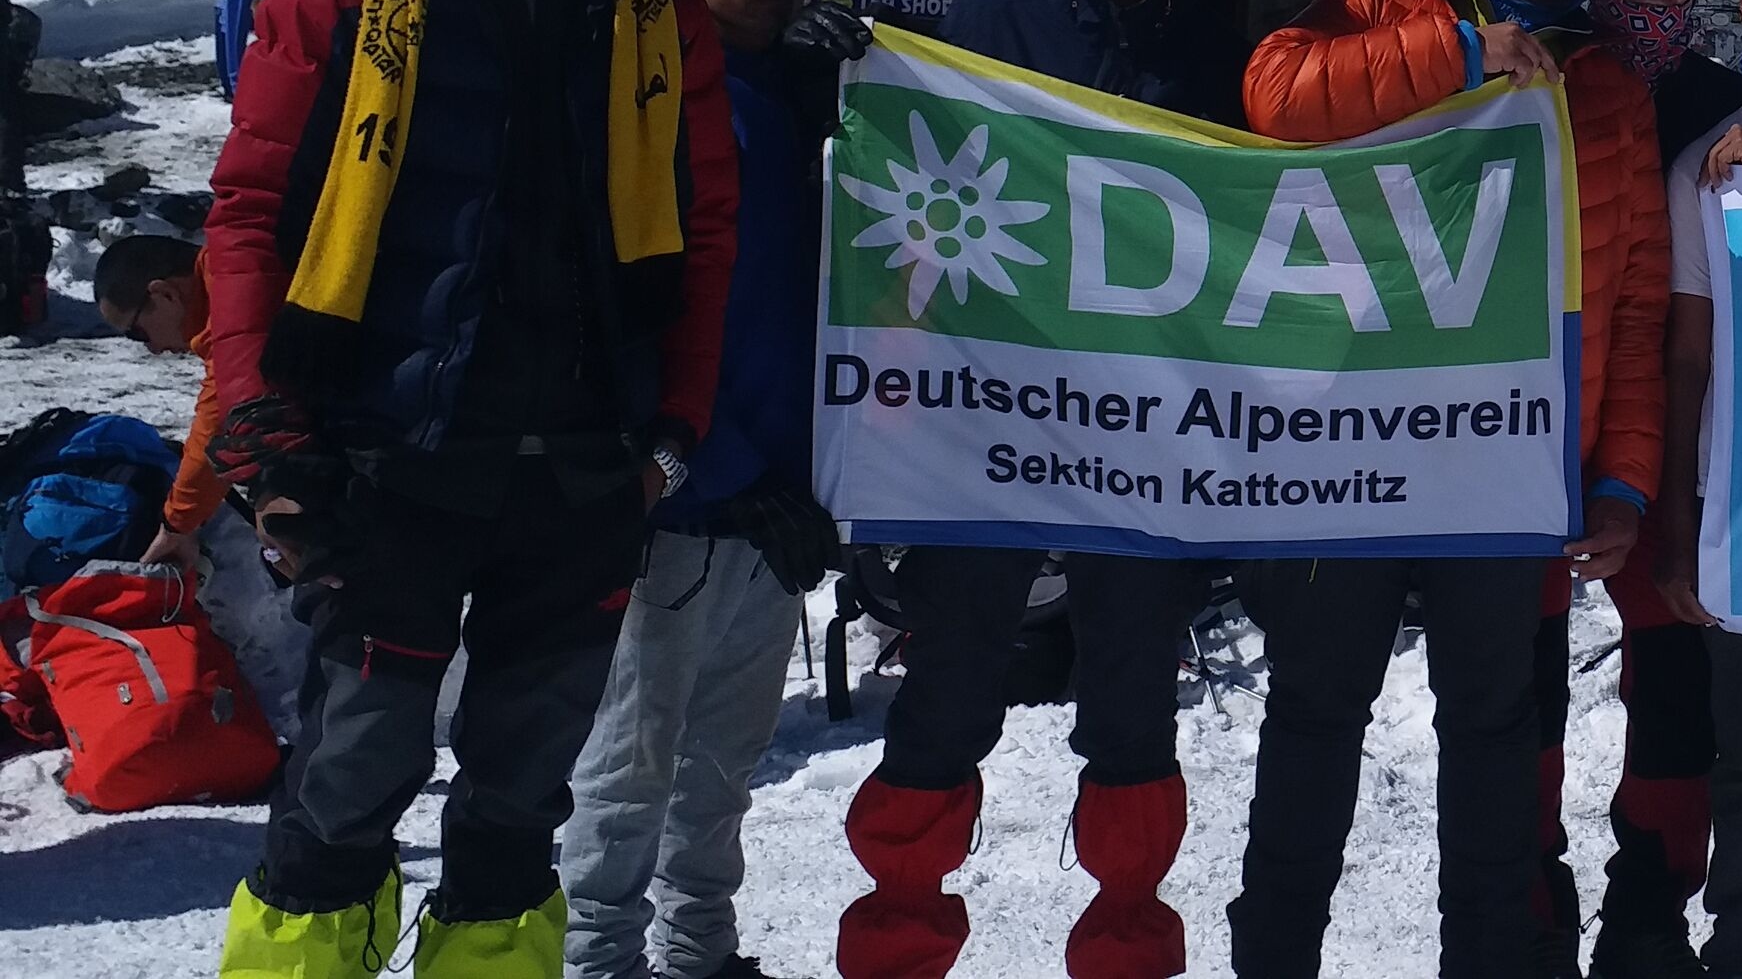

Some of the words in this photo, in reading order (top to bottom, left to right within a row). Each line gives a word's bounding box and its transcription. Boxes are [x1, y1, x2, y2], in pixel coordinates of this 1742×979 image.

[1066, 154, 1516, 332] DAV
[824, 354, 1162, 432] Deutscher
[1175, 387, 1551, 453] Alpenverein
[986, 443, 1162, 504] Sektion
[1181, 468, 1407, 507] Kattowitz
